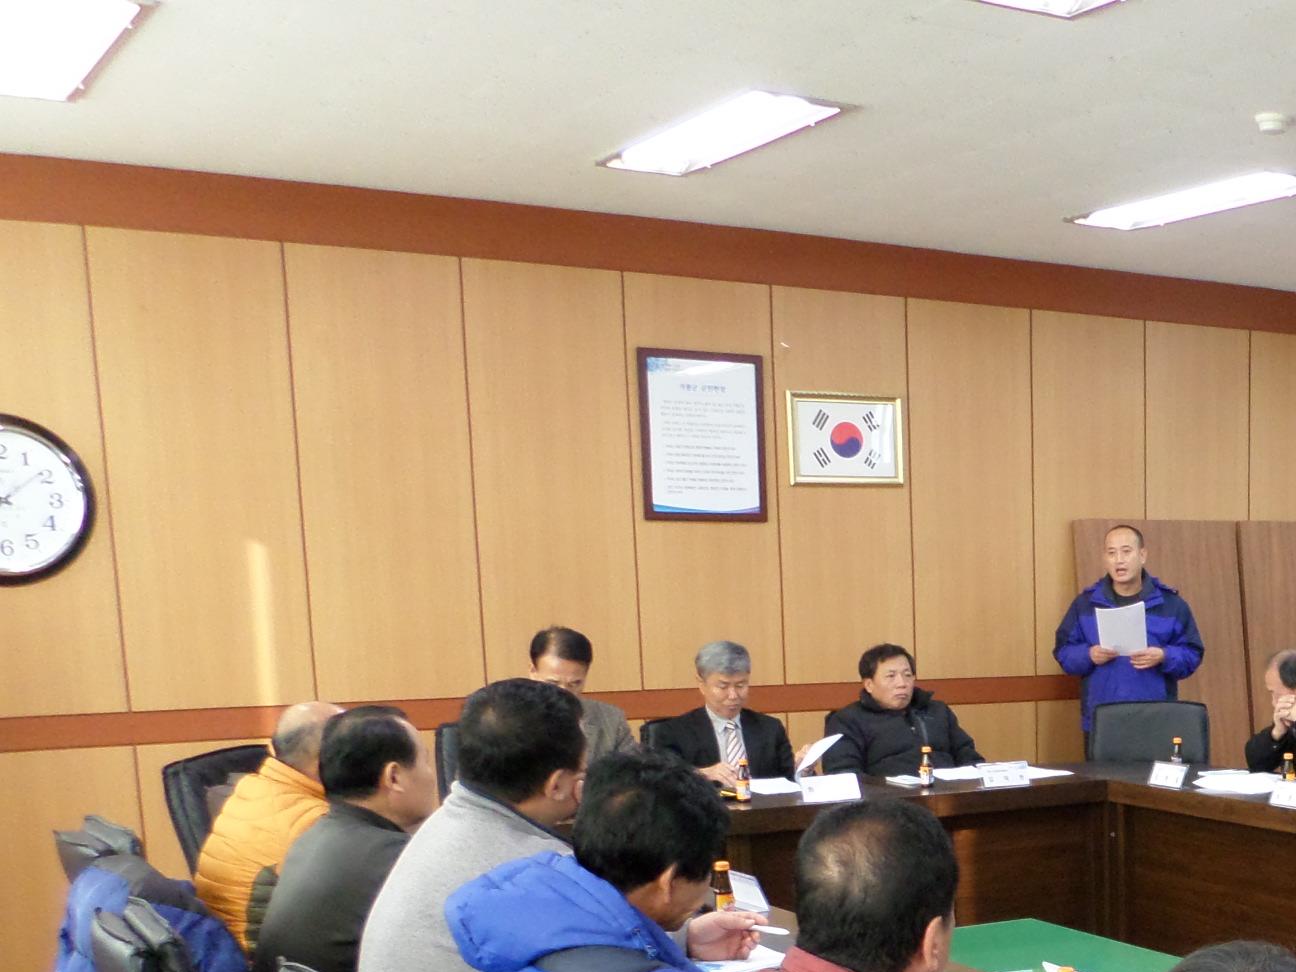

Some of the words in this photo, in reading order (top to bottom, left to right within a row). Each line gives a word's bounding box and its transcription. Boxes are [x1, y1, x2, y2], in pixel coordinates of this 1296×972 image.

[21, 452, 30, 466] 1
[38, 469, 53, 484] 2
[49, 493, 63, 508] 3
[42, 515, 56, 531] 4
[0, 540, 14, 556] 6
[25, 533, 39, 549] 5
